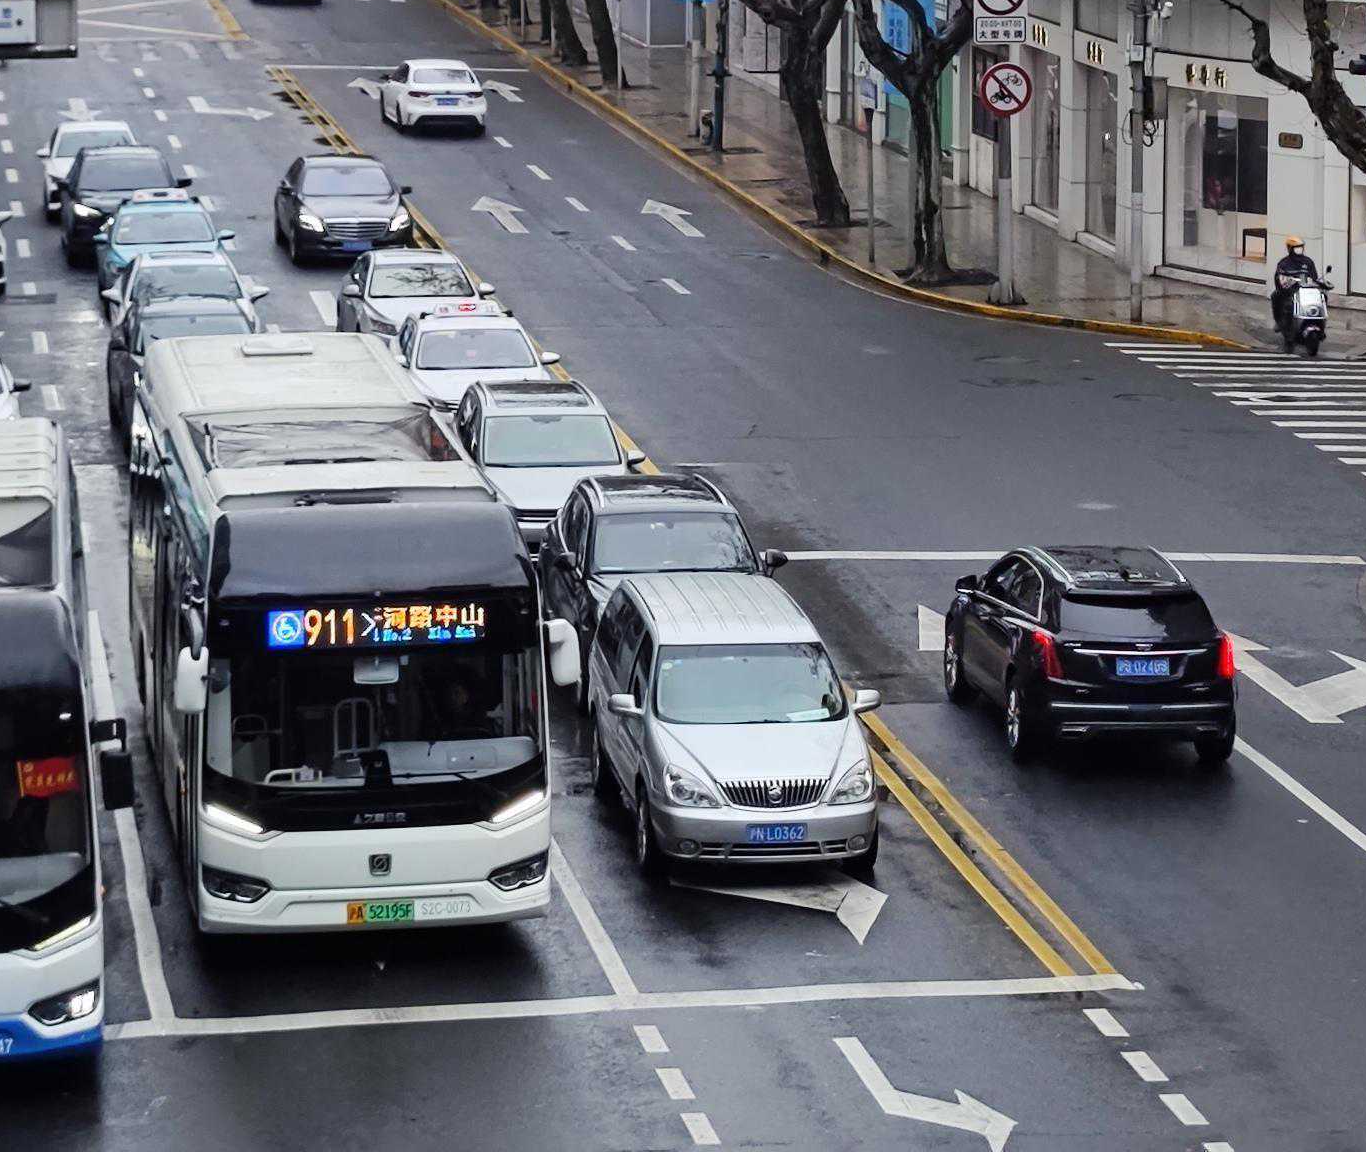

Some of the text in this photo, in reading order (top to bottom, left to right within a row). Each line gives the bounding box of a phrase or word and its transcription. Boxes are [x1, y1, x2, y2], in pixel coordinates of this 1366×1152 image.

[304, 608, 354, 646] 911
[374, 603, 485, 630] 河路中山
